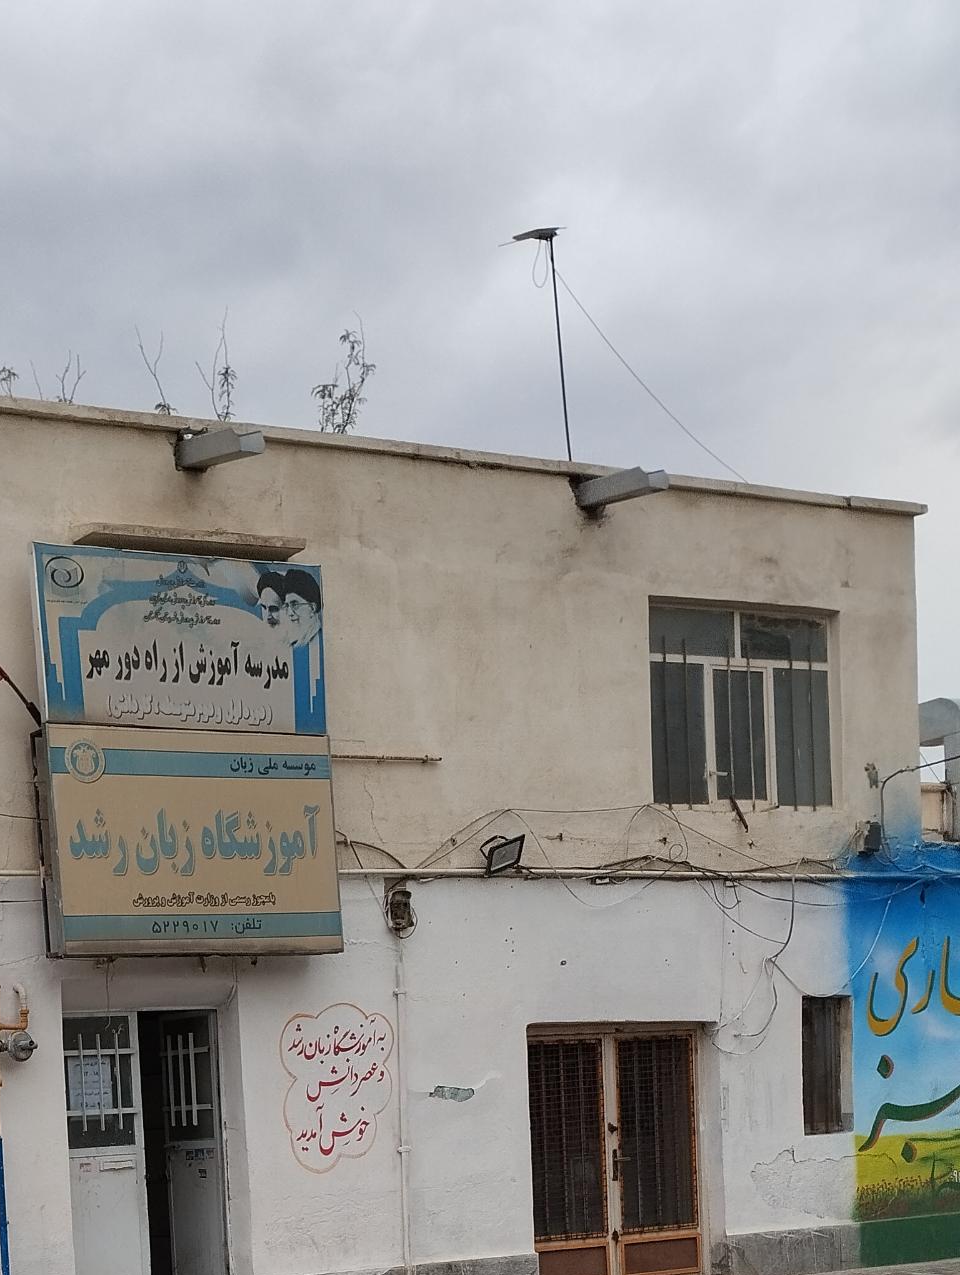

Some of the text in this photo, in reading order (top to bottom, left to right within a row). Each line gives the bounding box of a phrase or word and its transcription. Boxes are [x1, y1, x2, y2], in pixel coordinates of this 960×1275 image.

[86, 639, 289, 689] مدرسه آموزش از راه دور مهر
[230, 757, 316, 776] موسسه ملی زبان
[69, 804, 321, 877] آموزشگاه زبان رشد
[167, 891, 195, 907] آموزش
[288, 1017, 387, 1065] به آموزشگاه زبان رشد
[296, 1102, 370, 1156] خوش آمدید
